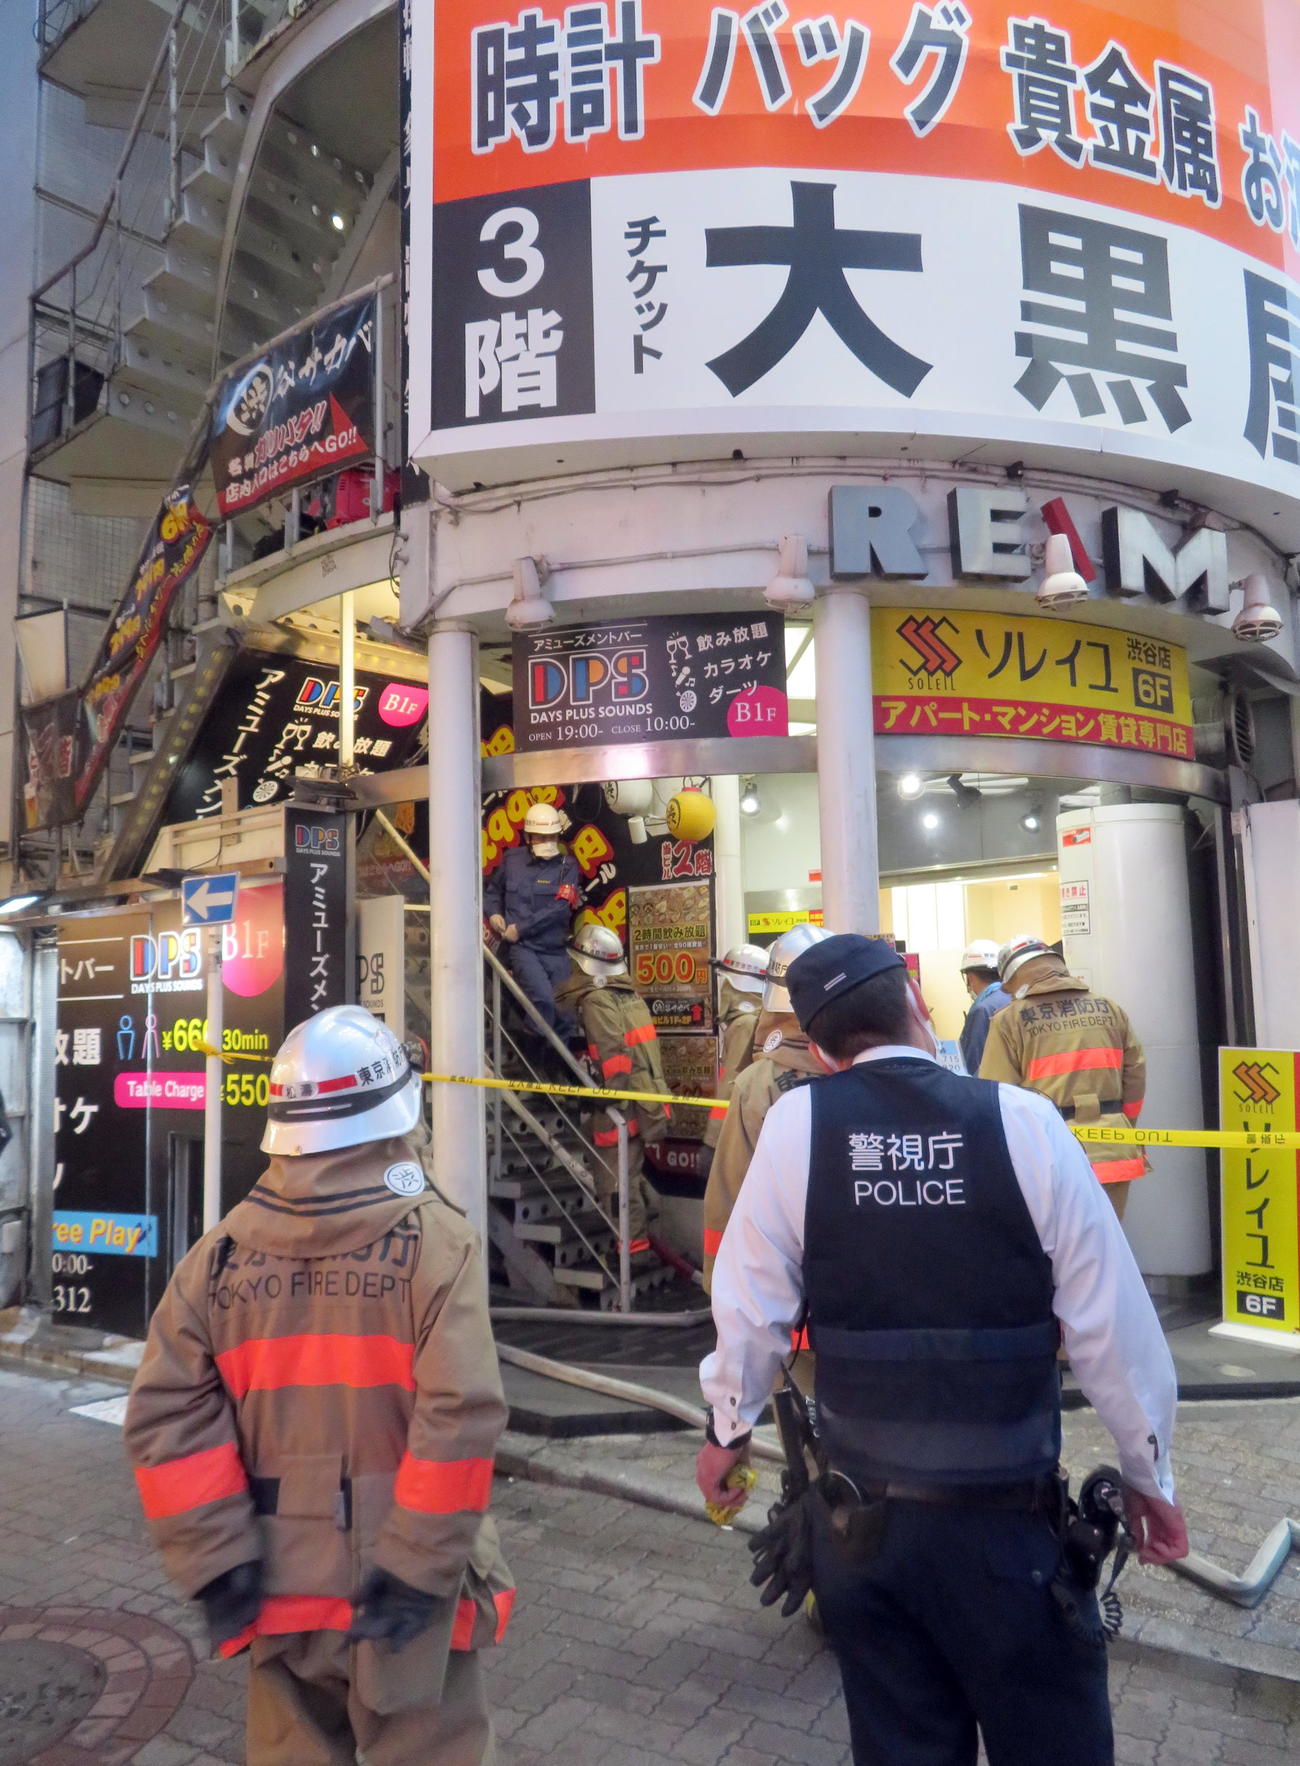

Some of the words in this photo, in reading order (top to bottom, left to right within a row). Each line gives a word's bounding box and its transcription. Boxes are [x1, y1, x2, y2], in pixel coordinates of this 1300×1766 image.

[472, 2, 661, 154] 時計
[693, 0, 970, 136] バッグ
[1003, 15, 1221, 210] 貴金属
[622, 216, 668, 375] チケット
[463, 205, 564, 418] 3階
[533, 631, 643, 652] アミューズメントバー
[696, 621, 768, 652] 飲み放題
[703, 650, 772, 679] カラオケ
[975, 629, 1119, 693] ソレイユ
[1127, 637, 1172, 670] 渋谷店
[528, 649, 649, 709] DPS
[708, 679, 759, 705] ダーツ
[907, 676, 957, 691] SOLEIL
[1136, 674, 1171, 706] 6F
[293, 704, 313, 715] DAYS
[313, 707, 330, 717] PLUS
[385, 693, 419, 715] B1F
[530, 709, 563, 724] DAYS
[565, 708, 596, 722] PLUS
[598, 703, 653, 718] SOUNDS
[735, 701, 777, 723] B1F
[529, 732, 552, 742] OPEN
[557, 724, 604, 741] 19:00-
[611, 724, 641, 735] CLOSE
[645, 715, 696, 733] 10:00-
[881, 700, 1188, 755] アパート・マンション賃貸専門店
[295, 825, 339, 850] DPS
[634, 924, 707, 941] 2時間飲み放題
[130, 927, 202, 981] DPS
[57, 958, 115, 984] トバー
[637, 951, 708, 985] 500円
[131, 983, 155, 994] DAYS
[156, 981, 173, 992] PLUS
[173, 979, 203, 992] SOUNDS
[1020, 998, 1111, 1028] 東京消防庁
[222, 1029, 269, 1051] 30min
[1027, 1022, 1062, 1038] TOKYO
[1063, 1019, 1088, 1032] FIRE
[1089, 1016, 1115, 1029] DEPT
[127, 1081, 162, 1097] Table
[165, 1081, 204, 1101] Charge
[1239, 1103, 1275, 1115] SOLEIL
[849, 1131, 963, 1171] 警視庁
[854, 1180, 966, 1206] POLICE
[90, 1218, 142, 1254] Play
[208, 1274, 281, 1310] TOKYO
[291, 1271, 338, 1296] FIRE
[345, 1271, 411, 1304] DEPT
[1236, 1271, 1285, 1293] 渋谷店
[1245, 1294, 1277, 1316] 6F
